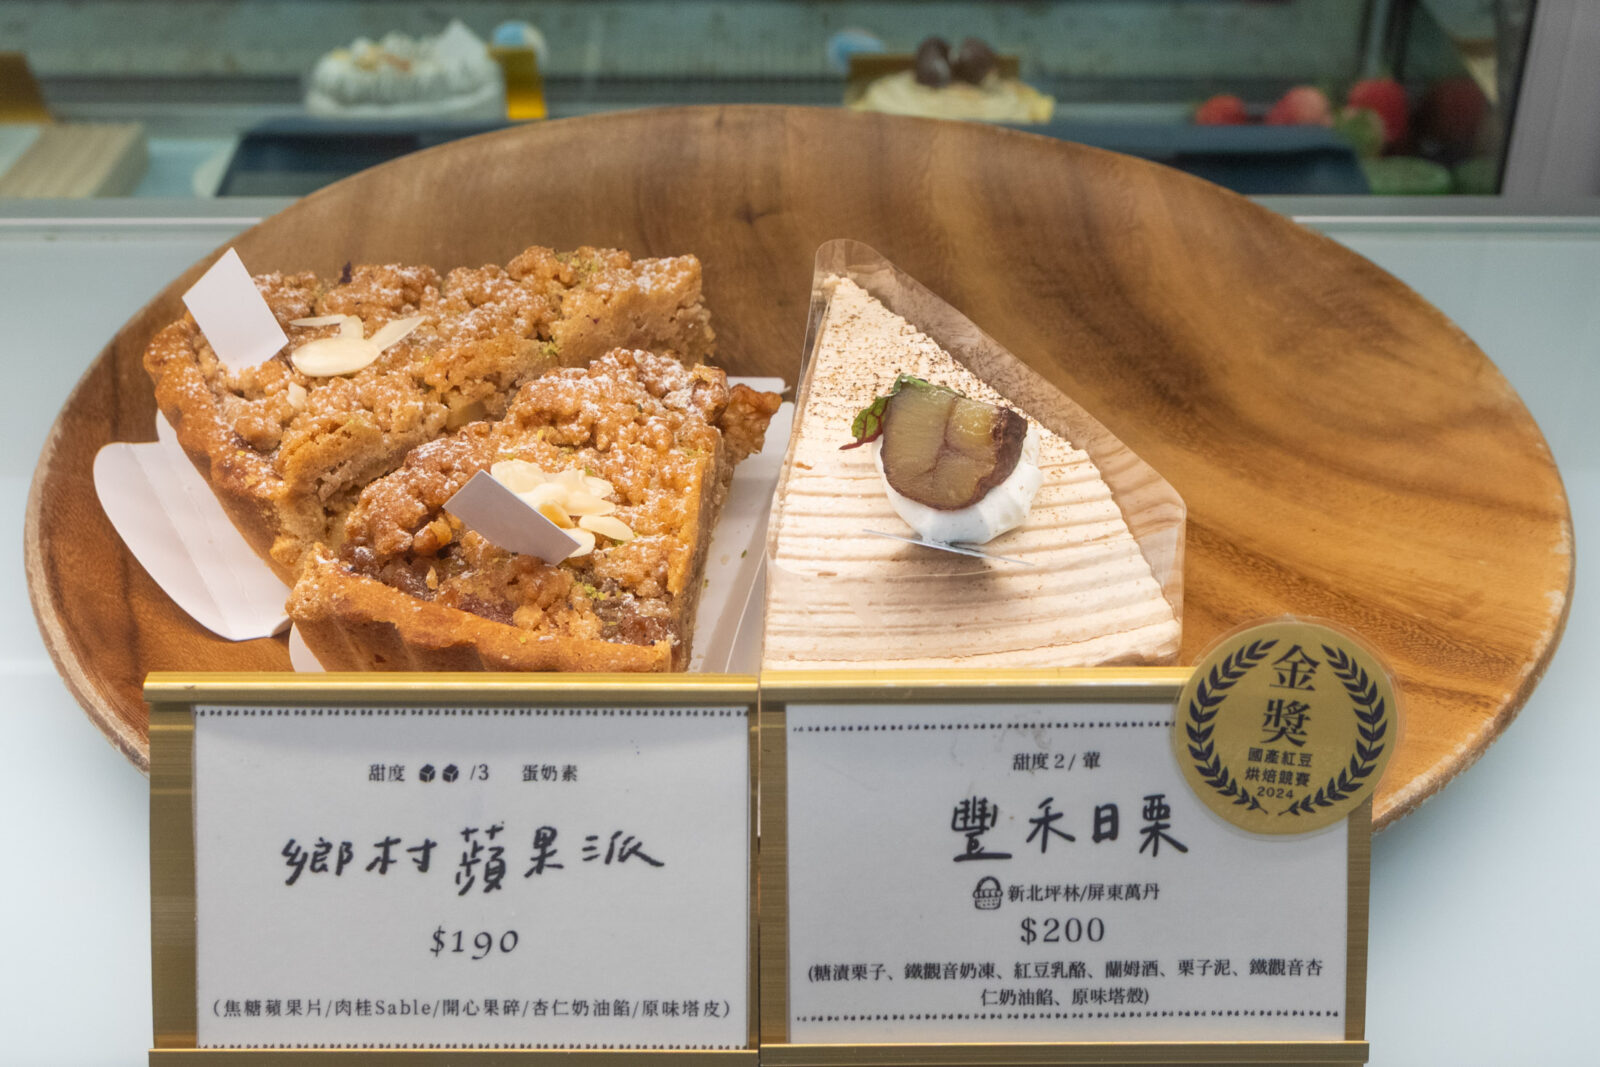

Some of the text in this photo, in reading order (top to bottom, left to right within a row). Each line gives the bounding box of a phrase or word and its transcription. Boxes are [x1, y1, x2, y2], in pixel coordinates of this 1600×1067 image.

[1261, 644, 1321, 747] 金獎
[1248, 746, 1313, 768] 國產紅豆
[368, 763, 406, 783] 甜度
[521, 763, 579, 783] 蛋奶素
[1244, 765, 1311, 788] 烘焙競賽
[1256, 785, 1294, 799] 2024
[951, 794, 1189, 863] 豐禾日栗
[281, 820, 665, 897] 鄉村蘋果派
[1008, 882, 1160, 904] 新北坪林/屏東萬丹
[1020, 917, 1105, 945] $200
[430, 925, 520, 961] $190
